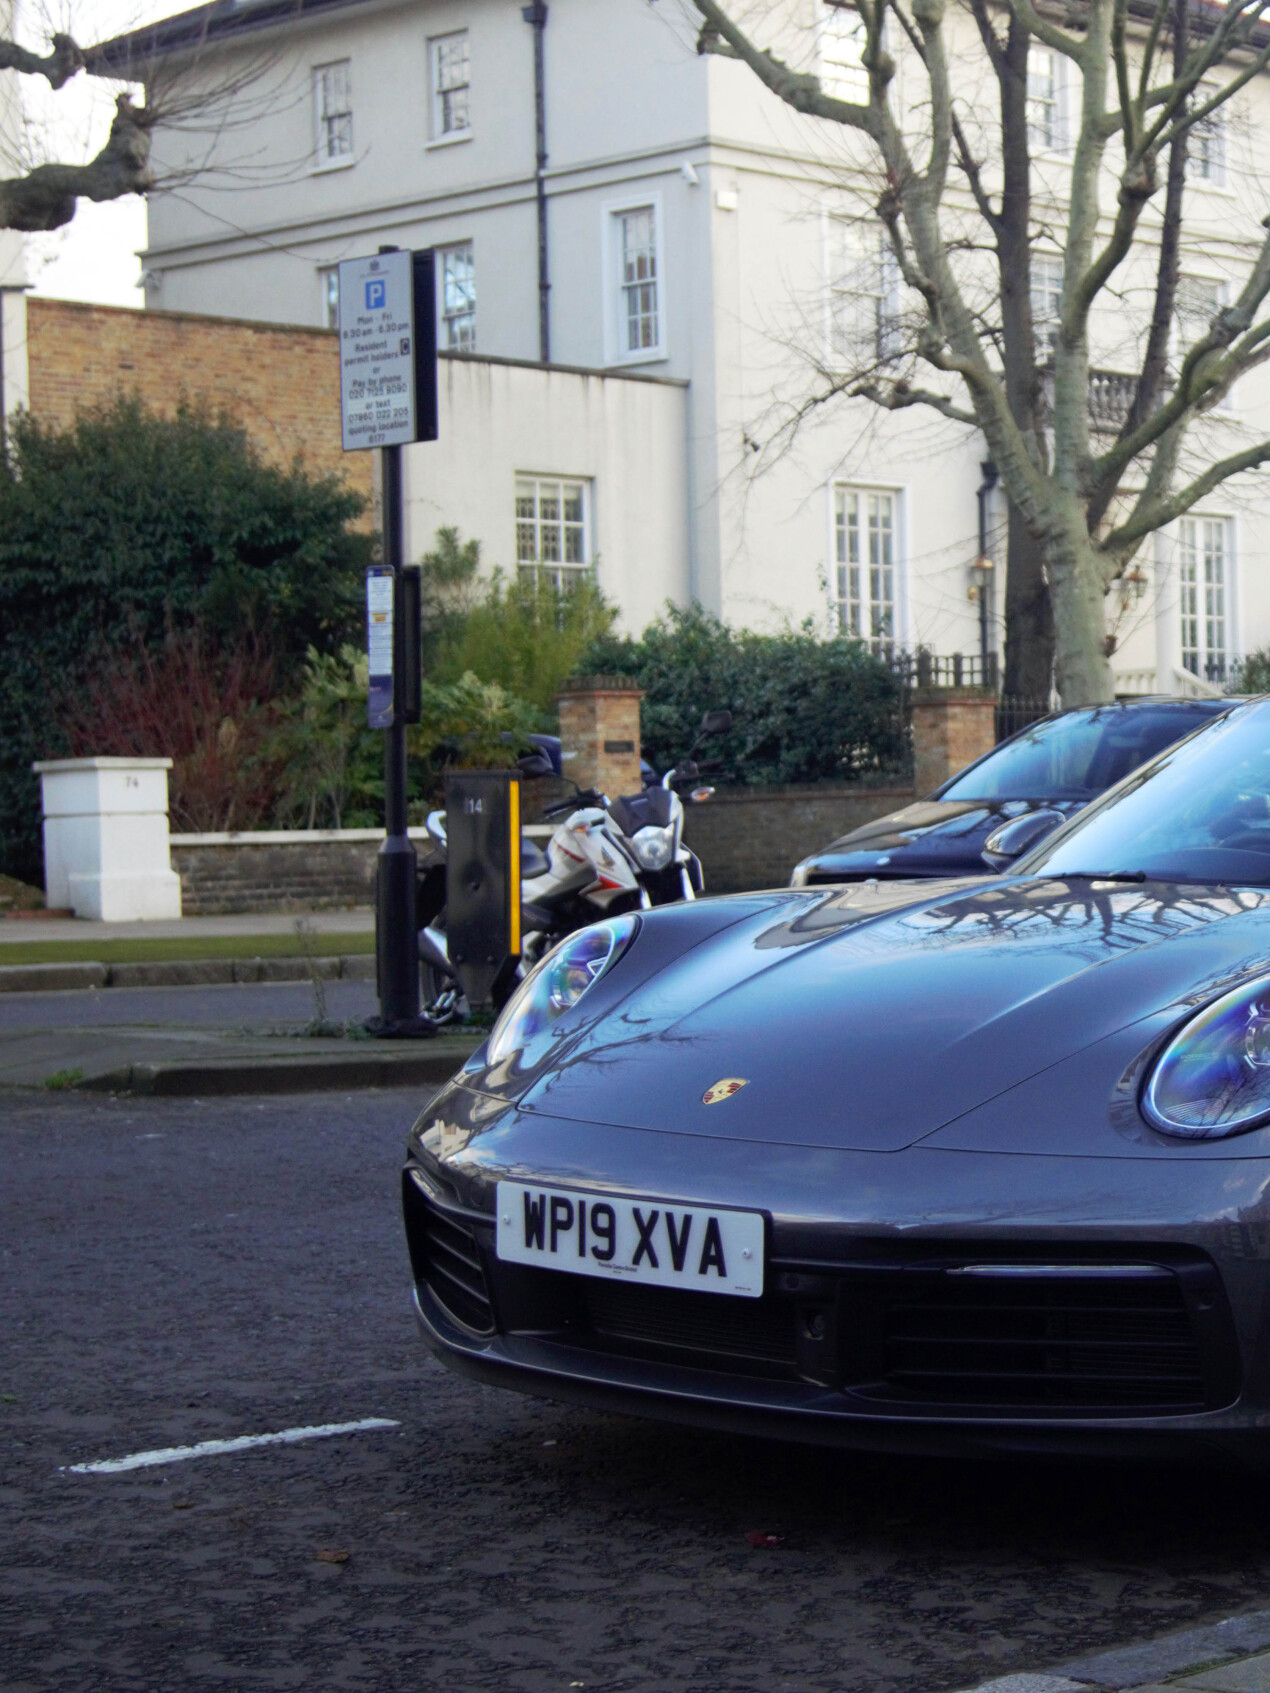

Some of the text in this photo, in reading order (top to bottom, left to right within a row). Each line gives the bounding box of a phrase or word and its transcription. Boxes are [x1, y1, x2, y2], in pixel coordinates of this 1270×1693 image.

[369, 283, 382, 307] P
[357, 316, 373, 325] Mon
[382, 312, 392, 321] Fri
[355, 340, 387, 352] Resident
[344, 351, 399, 367] permit holders
[373, 366, 381, 374] or
[353, 374, 401, 389] Pay by phone
[349, 389, 364, 400] 020
[375, 399, 390, 408] text
[379, 420, 408, 430] location
[468, 798, 483, 814] 14
[523, 1191, 728, 1278] WP19 XVA
